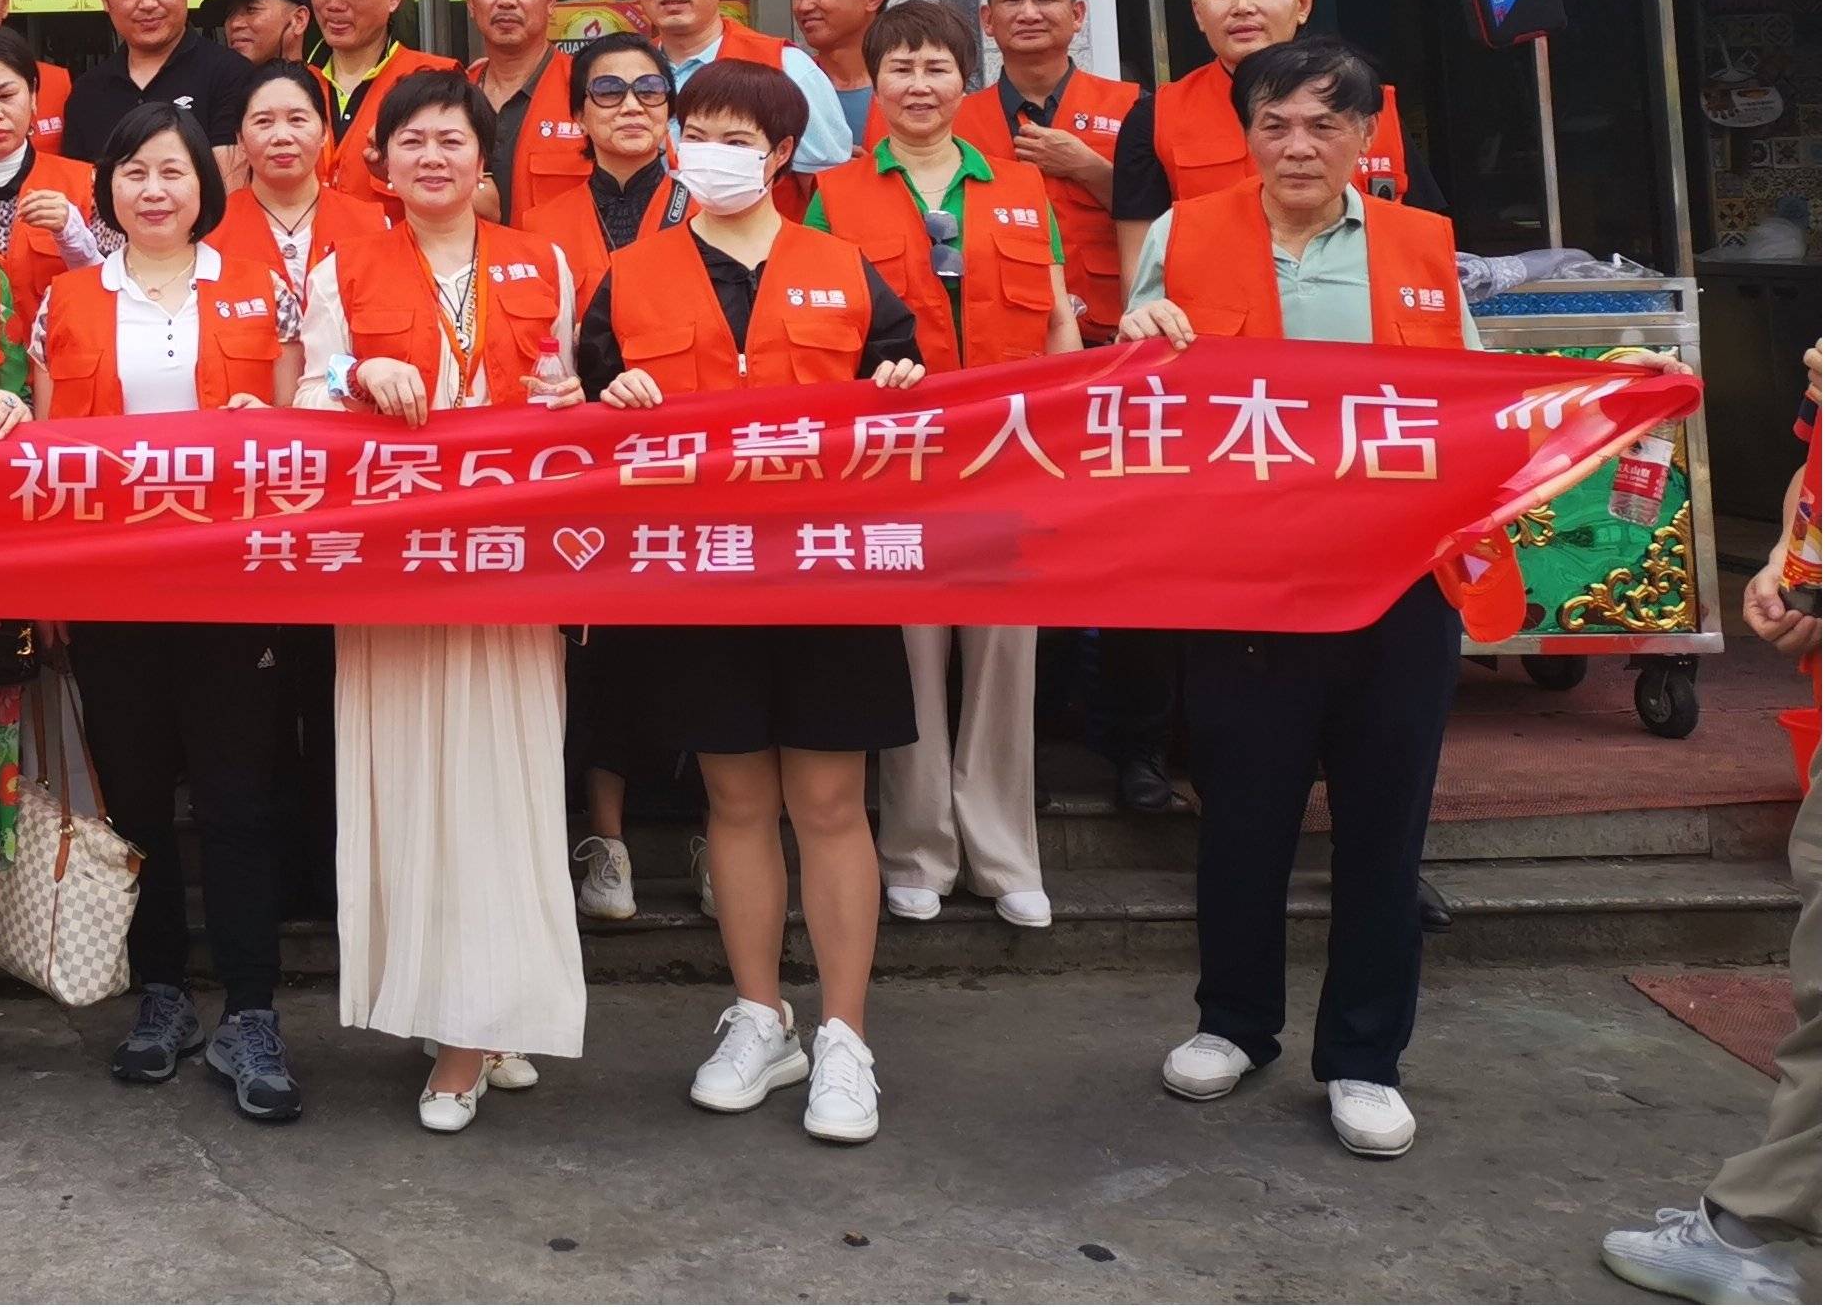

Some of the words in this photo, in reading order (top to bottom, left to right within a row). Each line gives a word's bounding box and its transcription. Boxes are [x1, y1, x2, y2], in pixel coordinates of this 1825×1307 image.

[555, 40, 589, 55] GUA
[810, 289, 846, 305] 搜堡
[242, 529, 364, 573] 共享
[402, 524, 526, 573] 共商
[630, 523, 756, 573] 共建
[795, 521, 926, 572] 共赢
